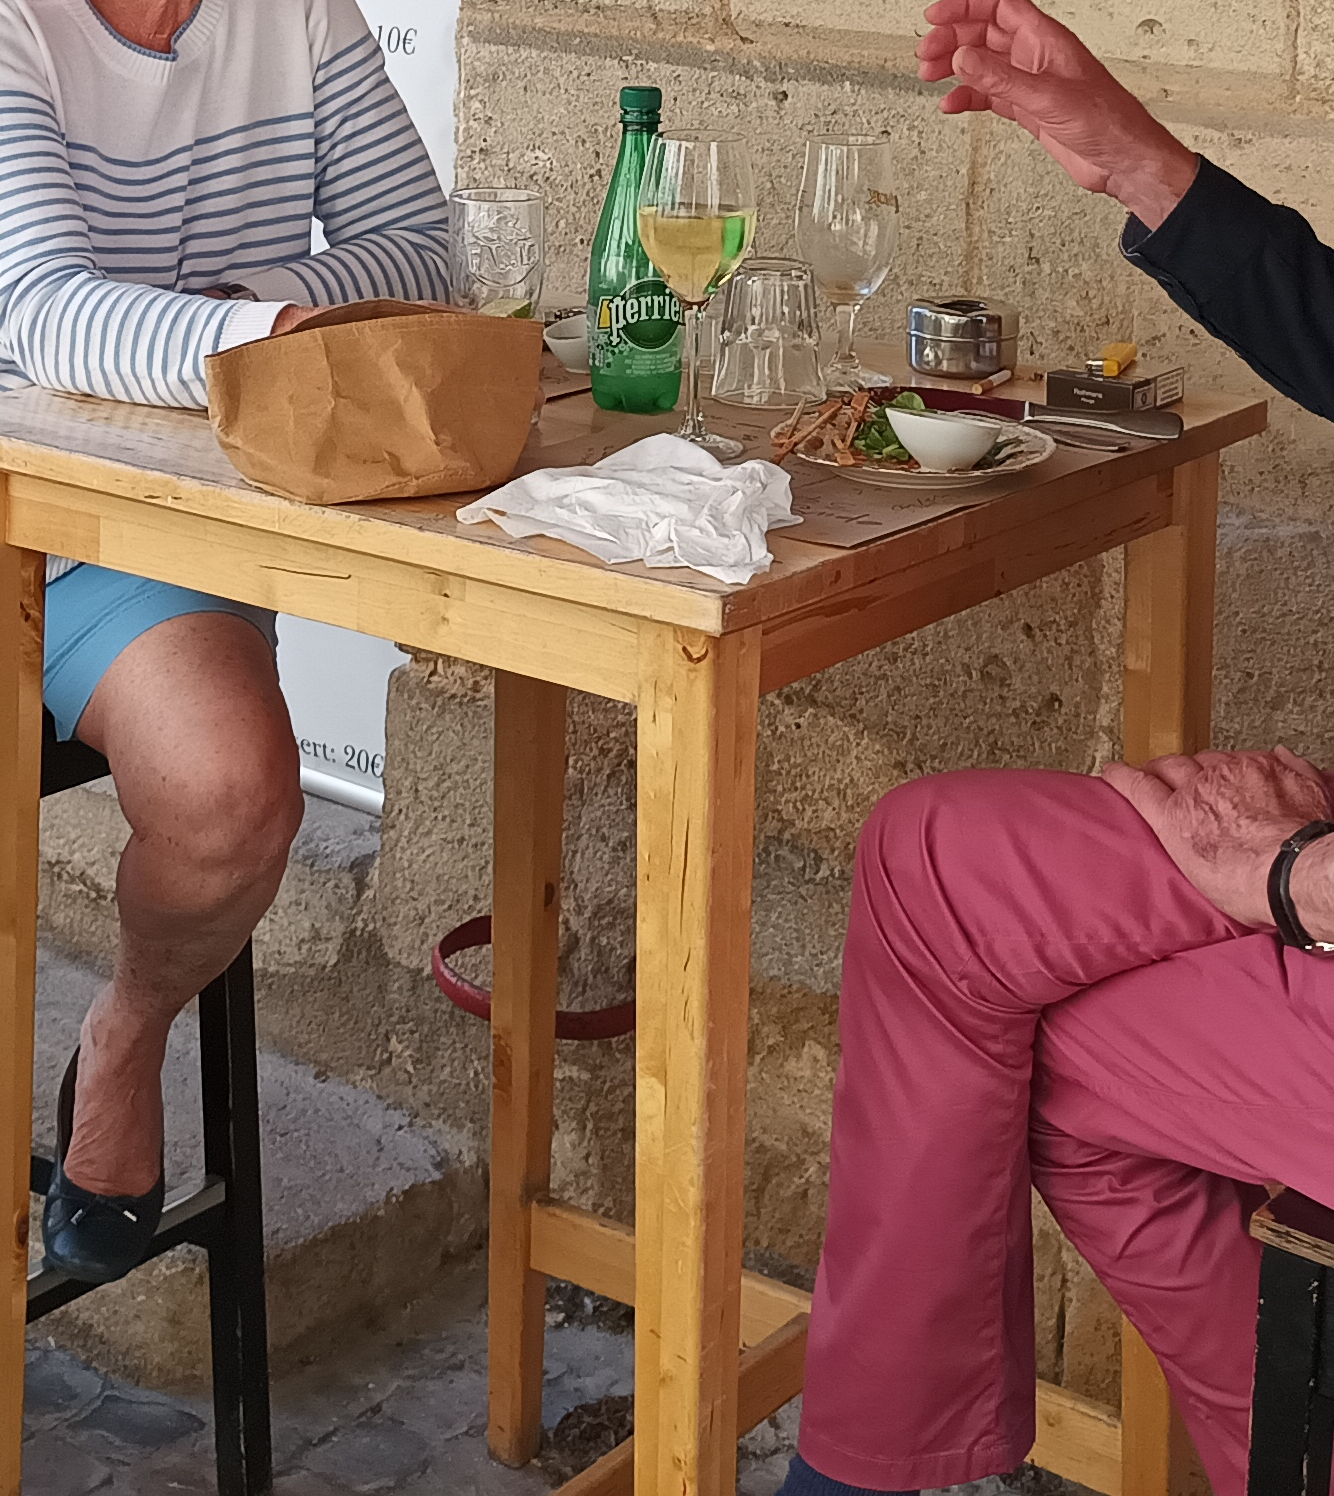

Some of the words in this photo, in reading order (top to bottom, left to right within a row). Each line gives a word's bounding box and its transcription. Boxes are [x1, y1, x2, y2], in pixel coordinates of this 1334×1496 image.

[376, 25, 417, 55] 10€
[296, 736, 337, 764] ert:
[343, 744, 384, 779] 20€
